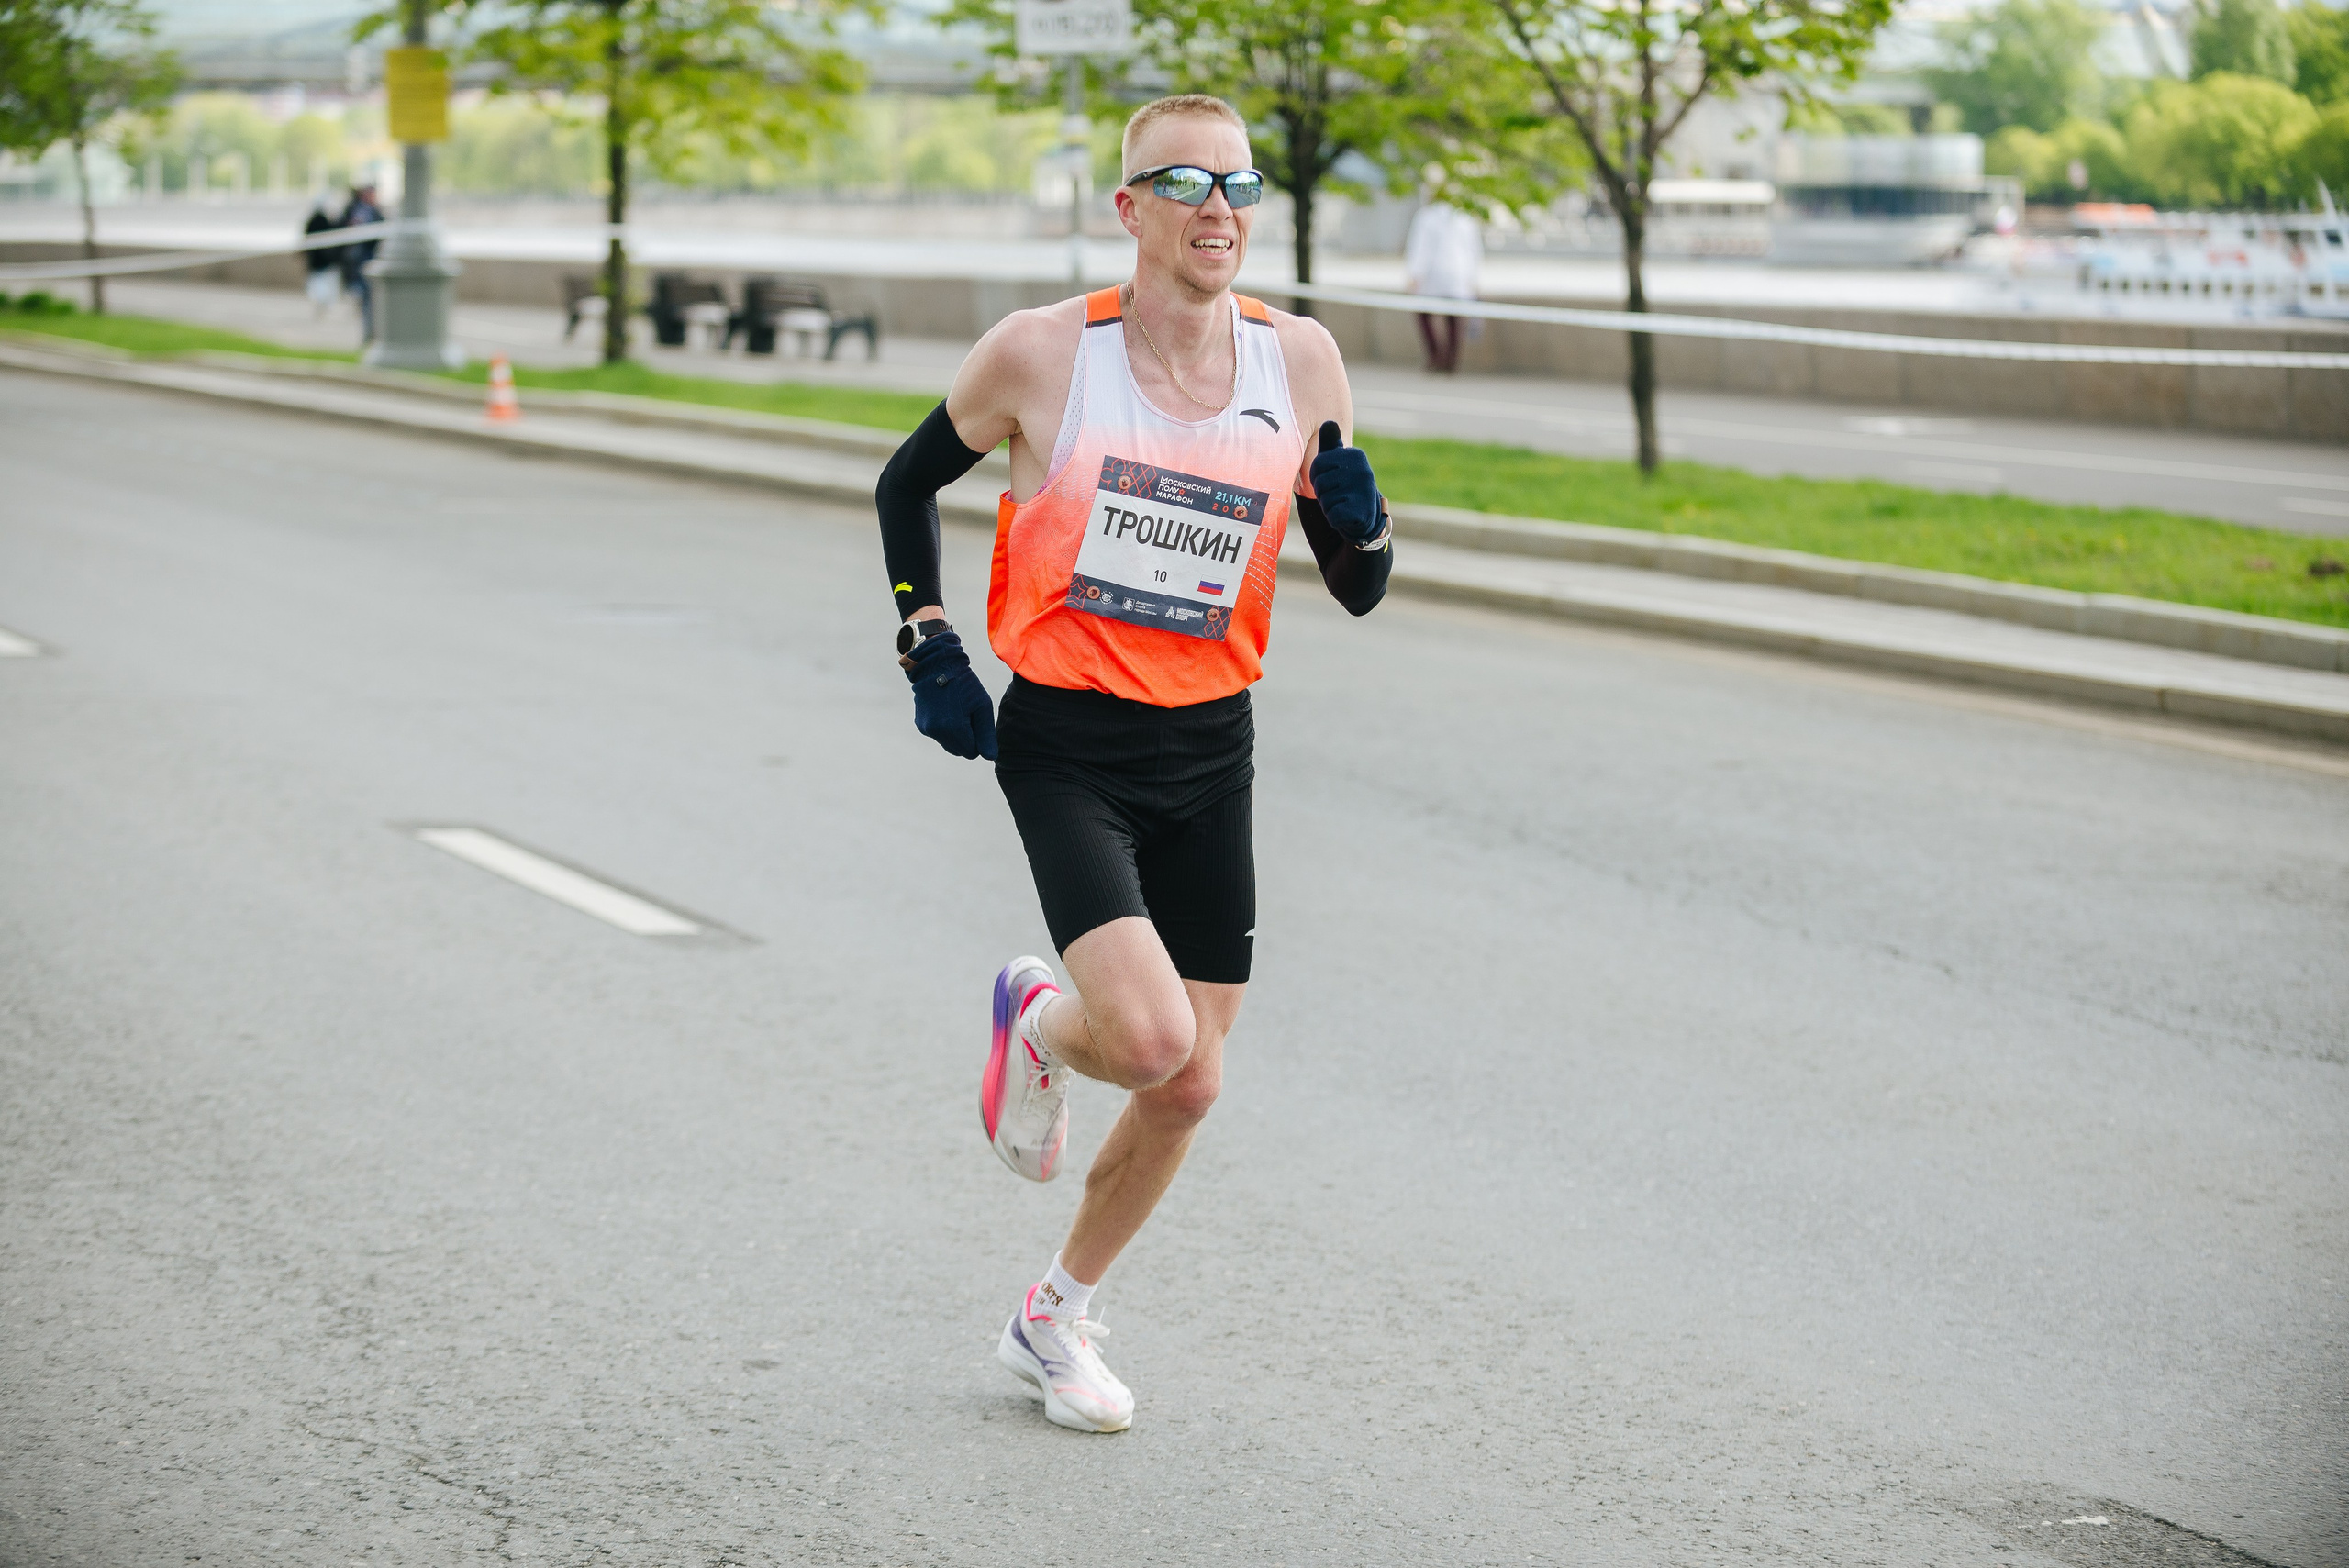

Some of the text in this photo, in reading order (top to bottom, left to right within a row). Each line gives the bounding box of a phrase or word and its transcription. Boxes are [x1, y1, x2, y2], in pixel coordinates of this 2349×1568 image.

[1158, 484, 1179, 495] ПОЛУ
[1160, 476, 1211, 495] МОСКОВСКИЙ
[1155, 491, 1194, 506] МАРАФОН
[1103, 506, 1242, 564] ТРОШКИН
[1153, 570, 1167, 583] 10
